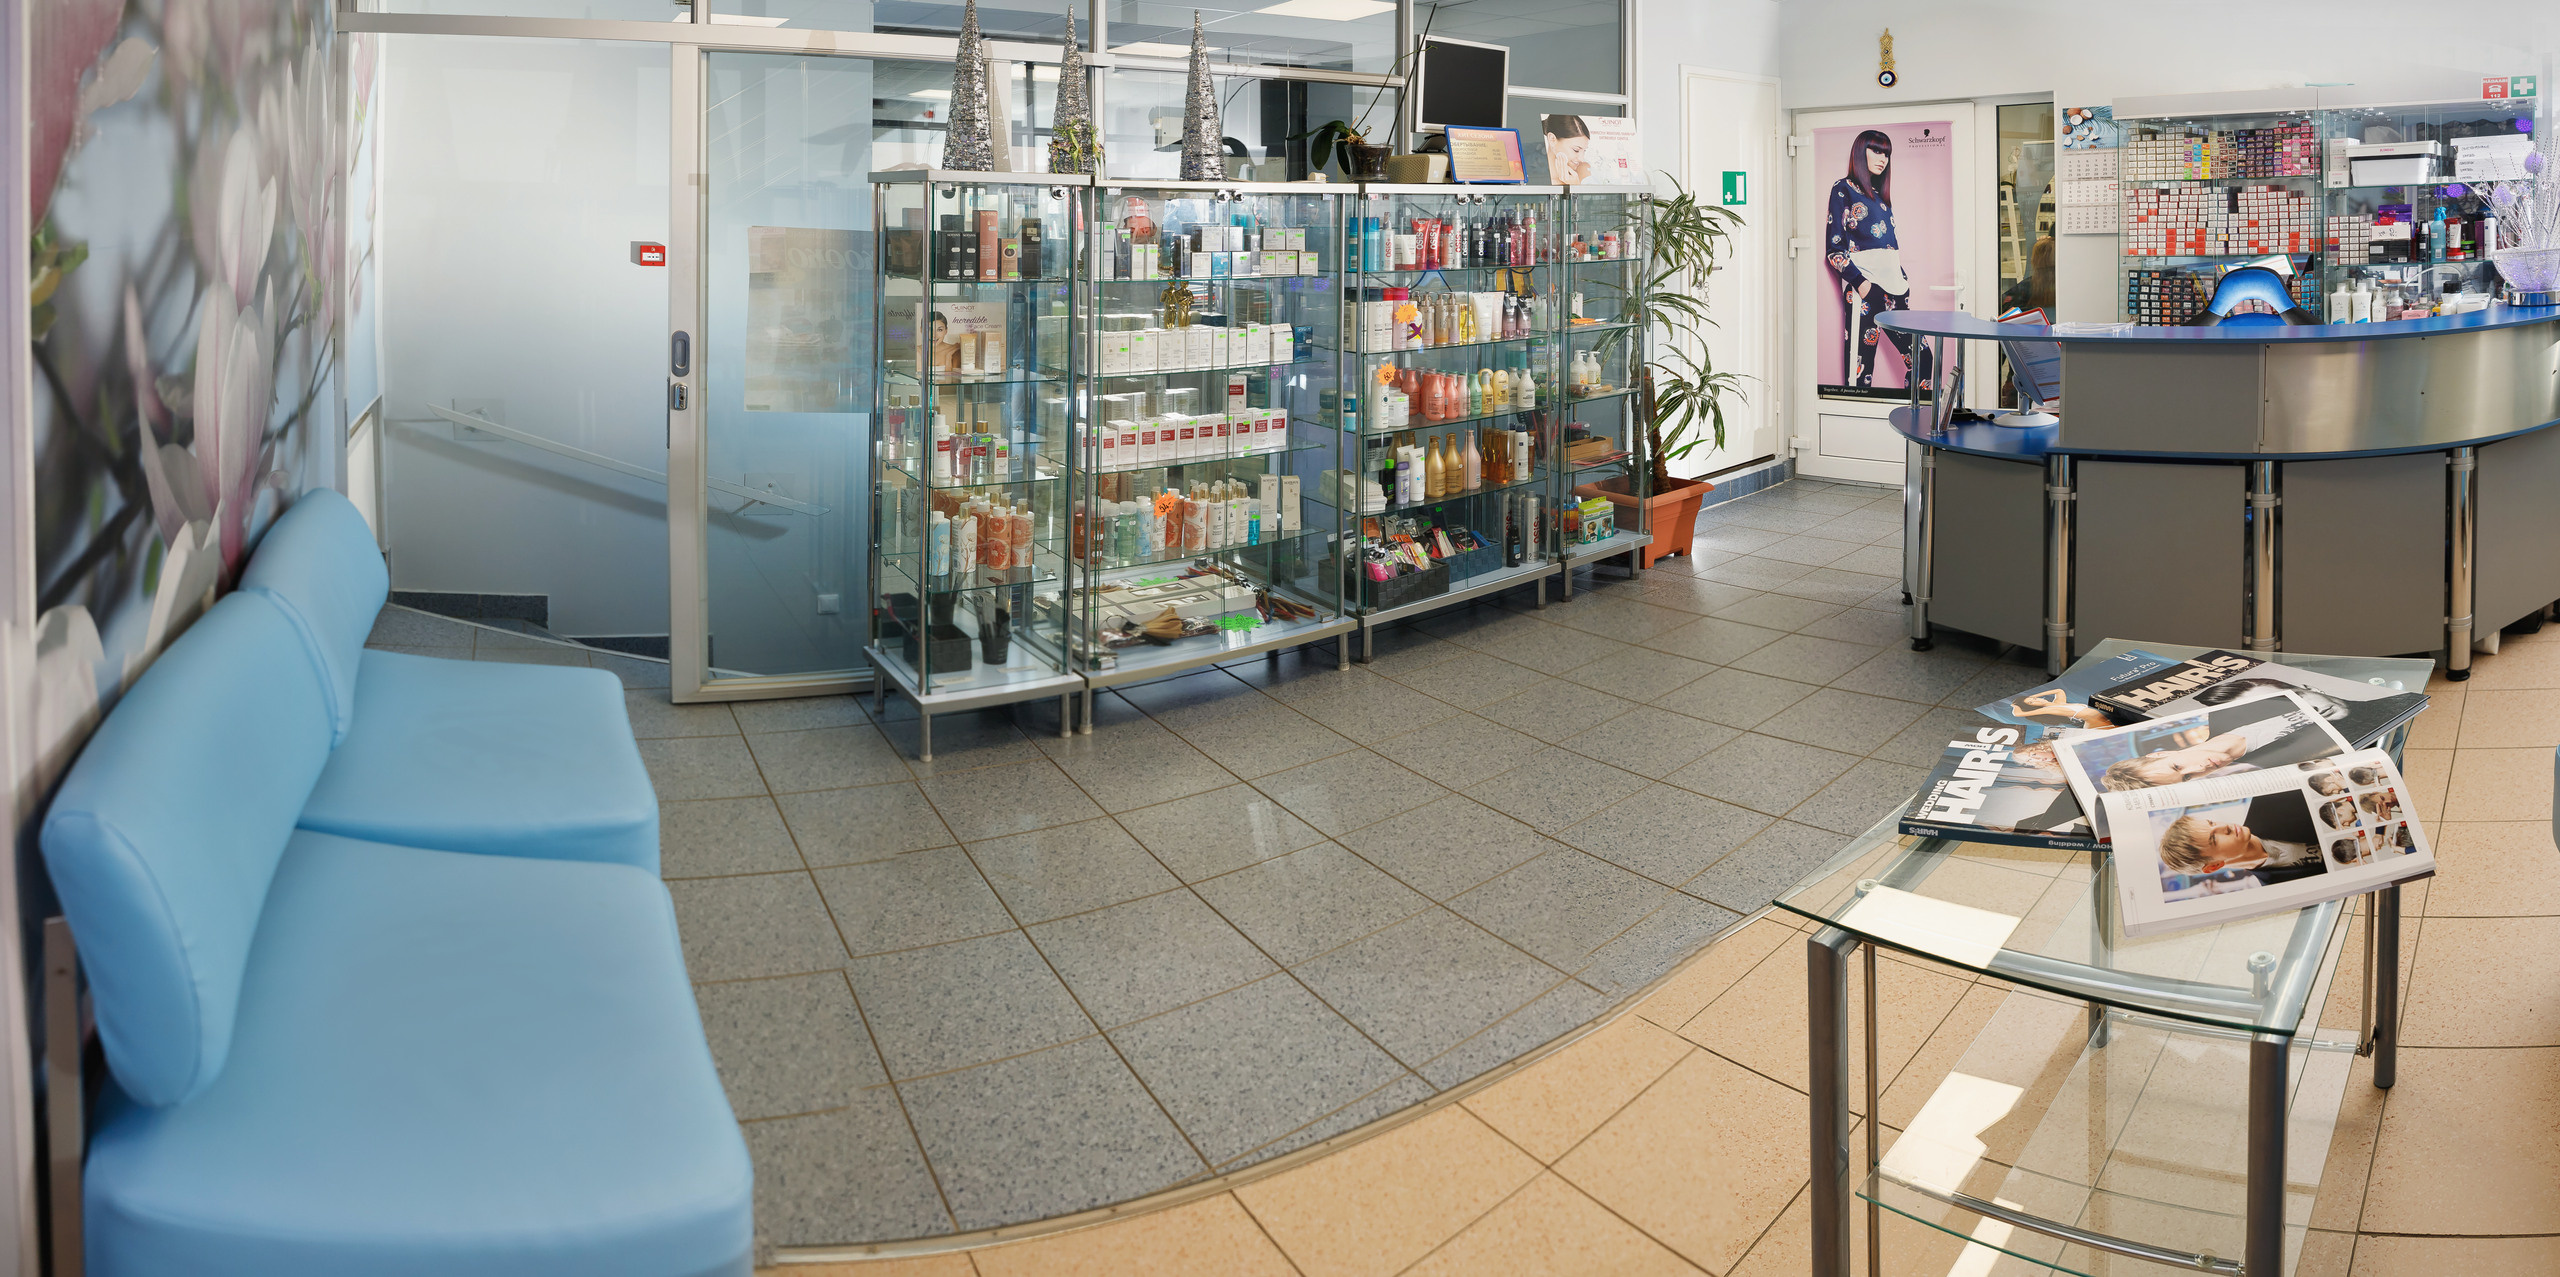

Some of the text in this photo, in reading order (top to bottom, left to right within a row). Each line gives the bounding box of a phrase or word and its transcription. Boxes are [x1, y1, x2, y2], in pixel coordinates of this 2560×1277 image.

[1908, 136, 1946, 144] Schwarzkopf
[2139, 660, 2157, 670] Pro
[1915, 779, 1949, 820] WEDDING
[2048, 840, 2084, 848] wedding
